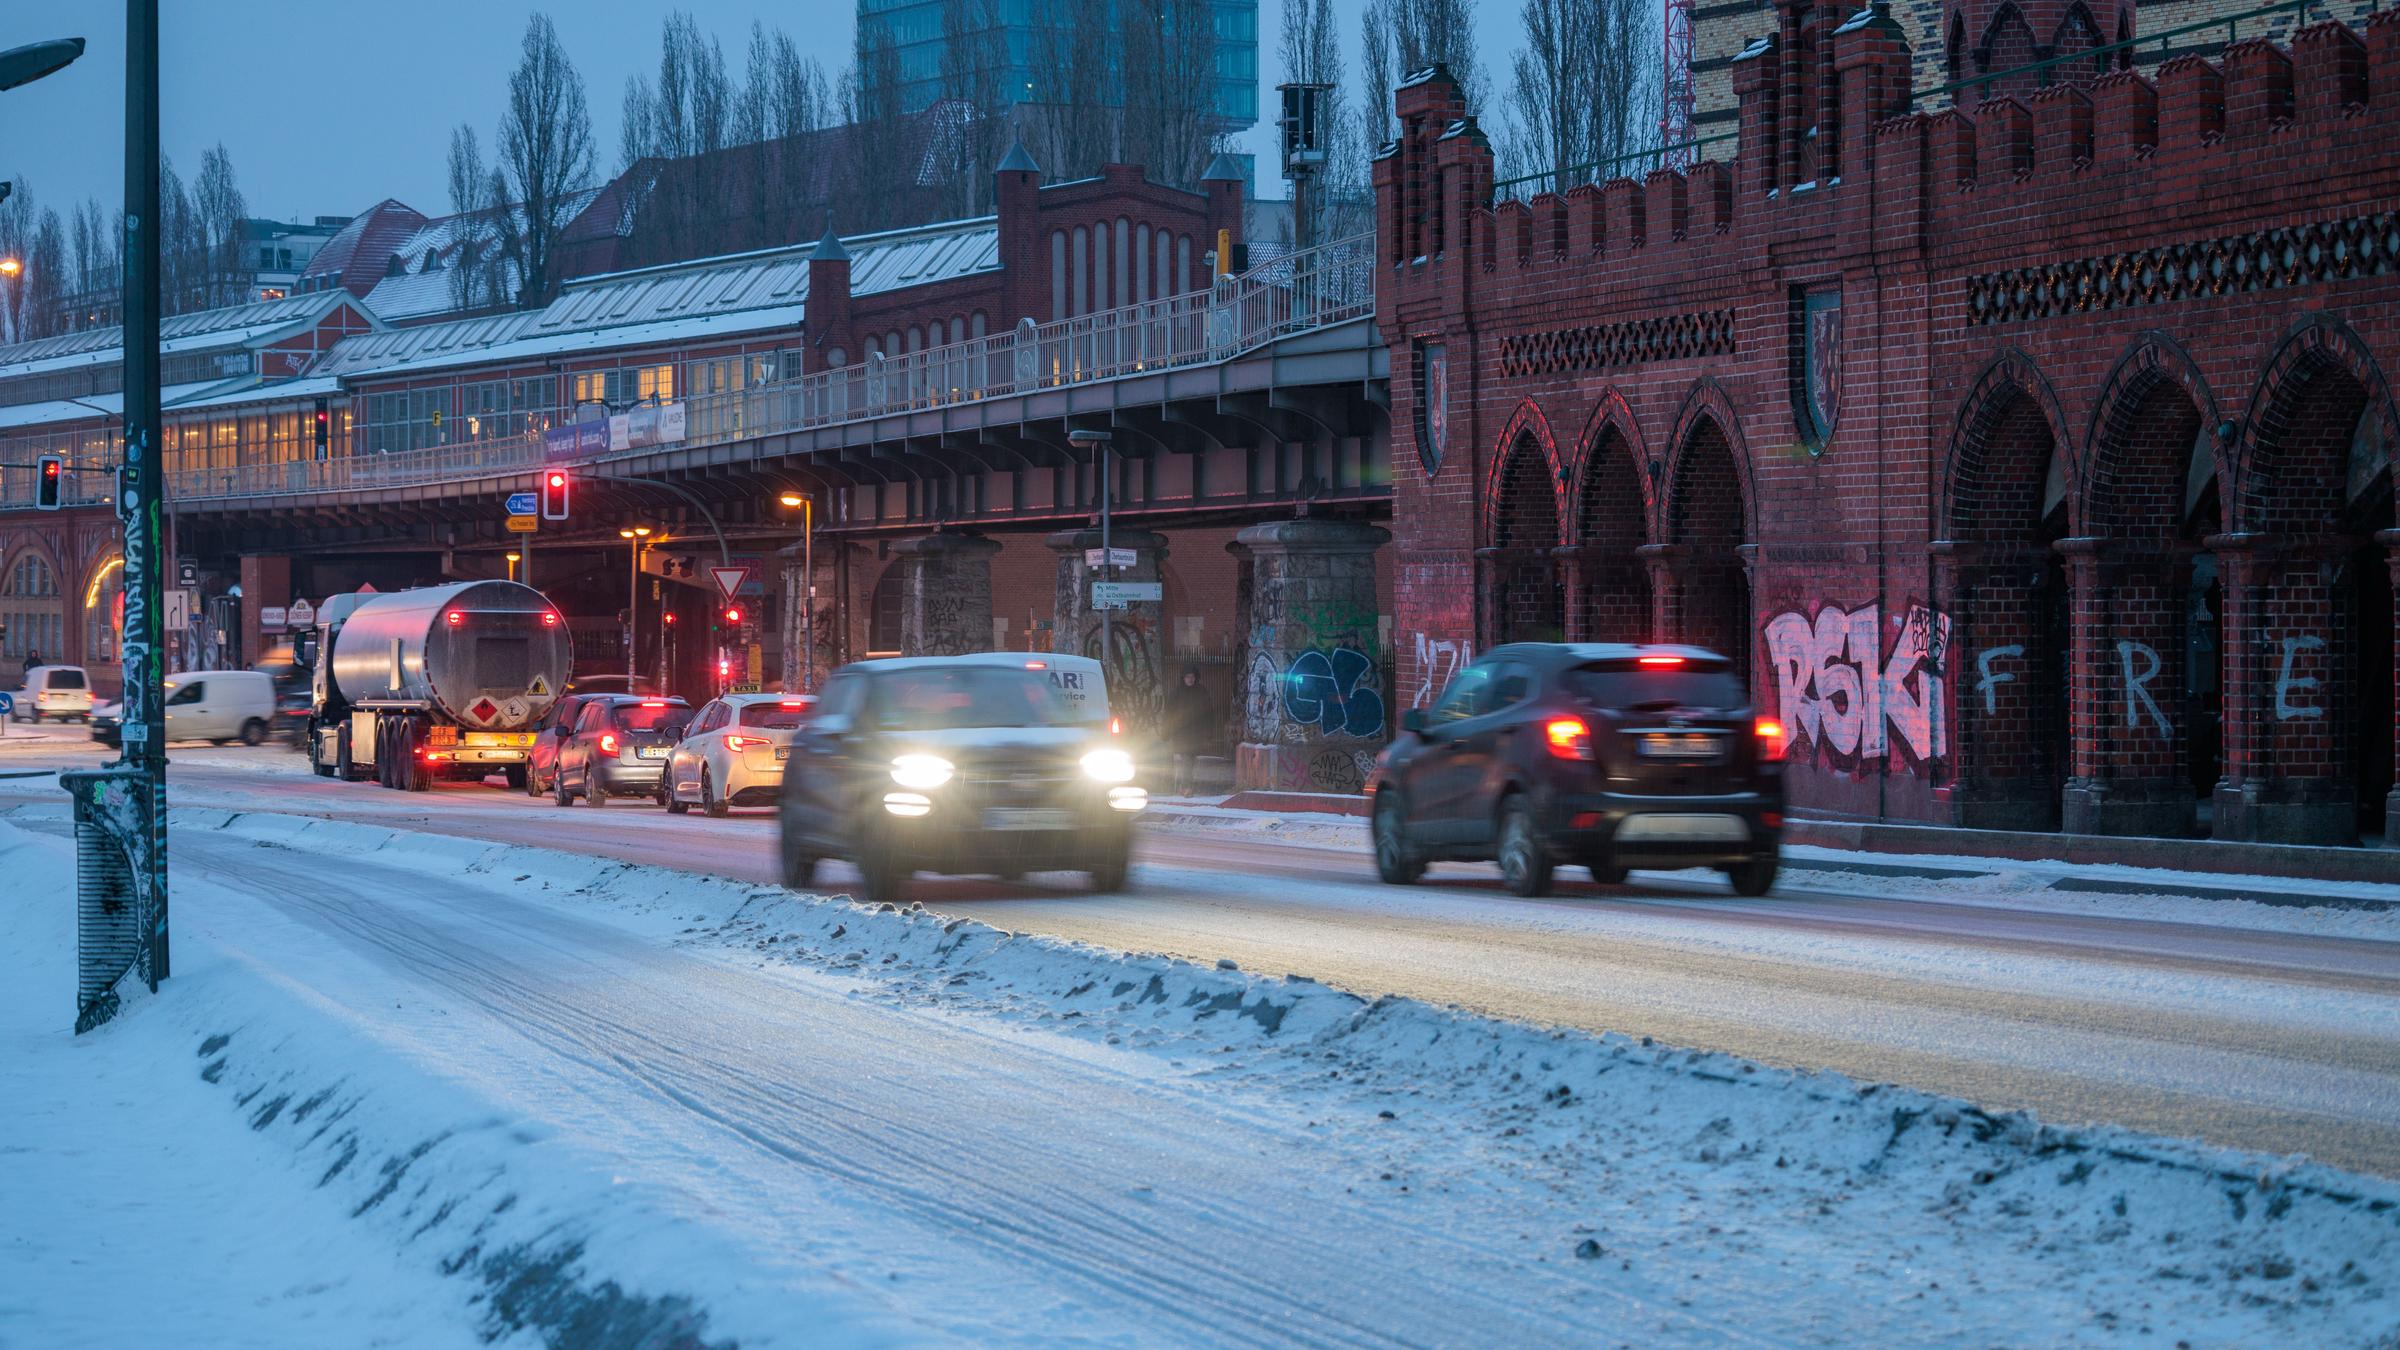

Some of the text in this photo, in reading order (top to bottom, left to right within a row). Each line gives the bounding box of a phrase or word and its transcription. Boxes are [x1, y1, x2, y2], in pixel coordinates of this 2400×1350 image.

[1975, 636, 2324, 738] F R E
